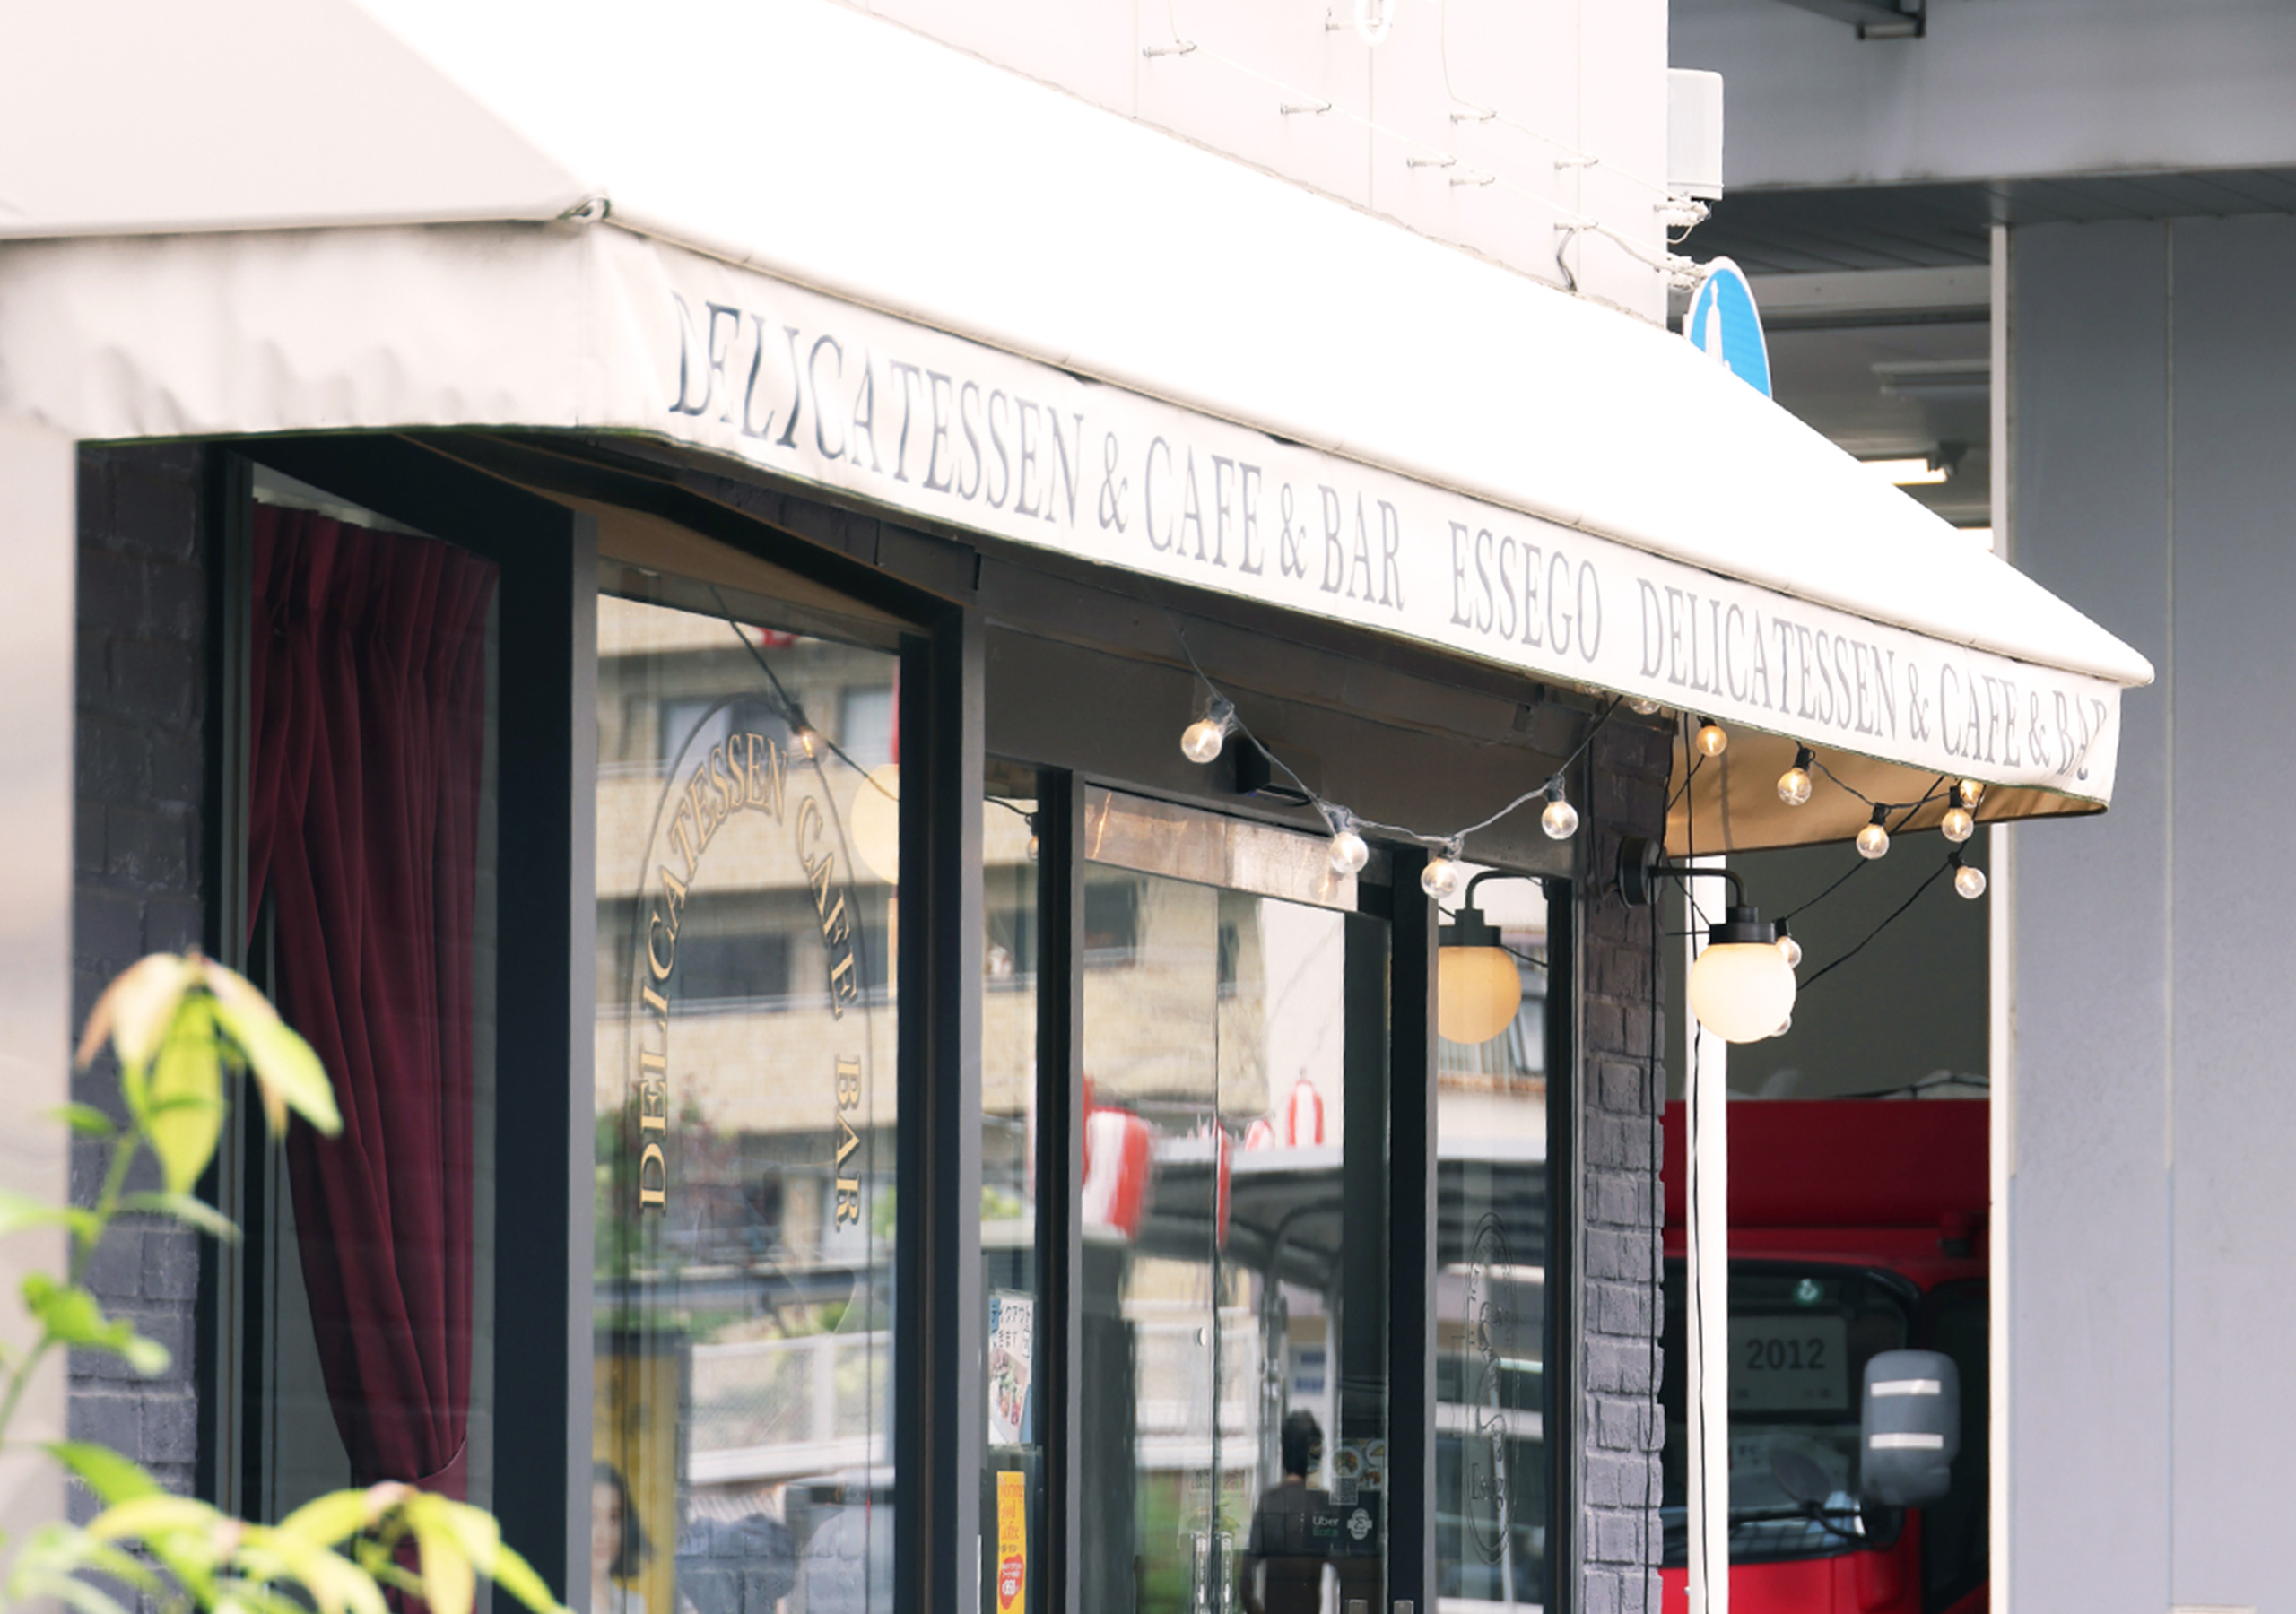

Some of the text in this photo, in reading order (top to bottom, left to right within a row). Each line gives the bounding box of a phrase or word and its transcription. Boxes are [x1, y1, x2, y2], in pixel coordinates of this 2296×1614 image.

[669, 290, 1083, 529] DELICATESSEN
[1098, 431, 1128, 534] &
[1144, 436, 1263, 577] CAFE
[1280, 482, 1308, 579] &
[1318, 484, 1405, 612] BAR
[1448, 520, 1603, 663] ESSEGO
[1636, 577, 1897, 742] DELICATESSEN
[1909, 663, 1930, 741] &
[1940, 664, 2021, 768] CAFE
[2029, 690, 2050, 768] &
[639, 733, 861, 1232] DELICATESSEN CAFE BAR
[1747, 1338, 1826, 1370] 2012
[1312, 1515, 1339, 1526] Uber
[1312, 1526, 1339, 1537] Eats
